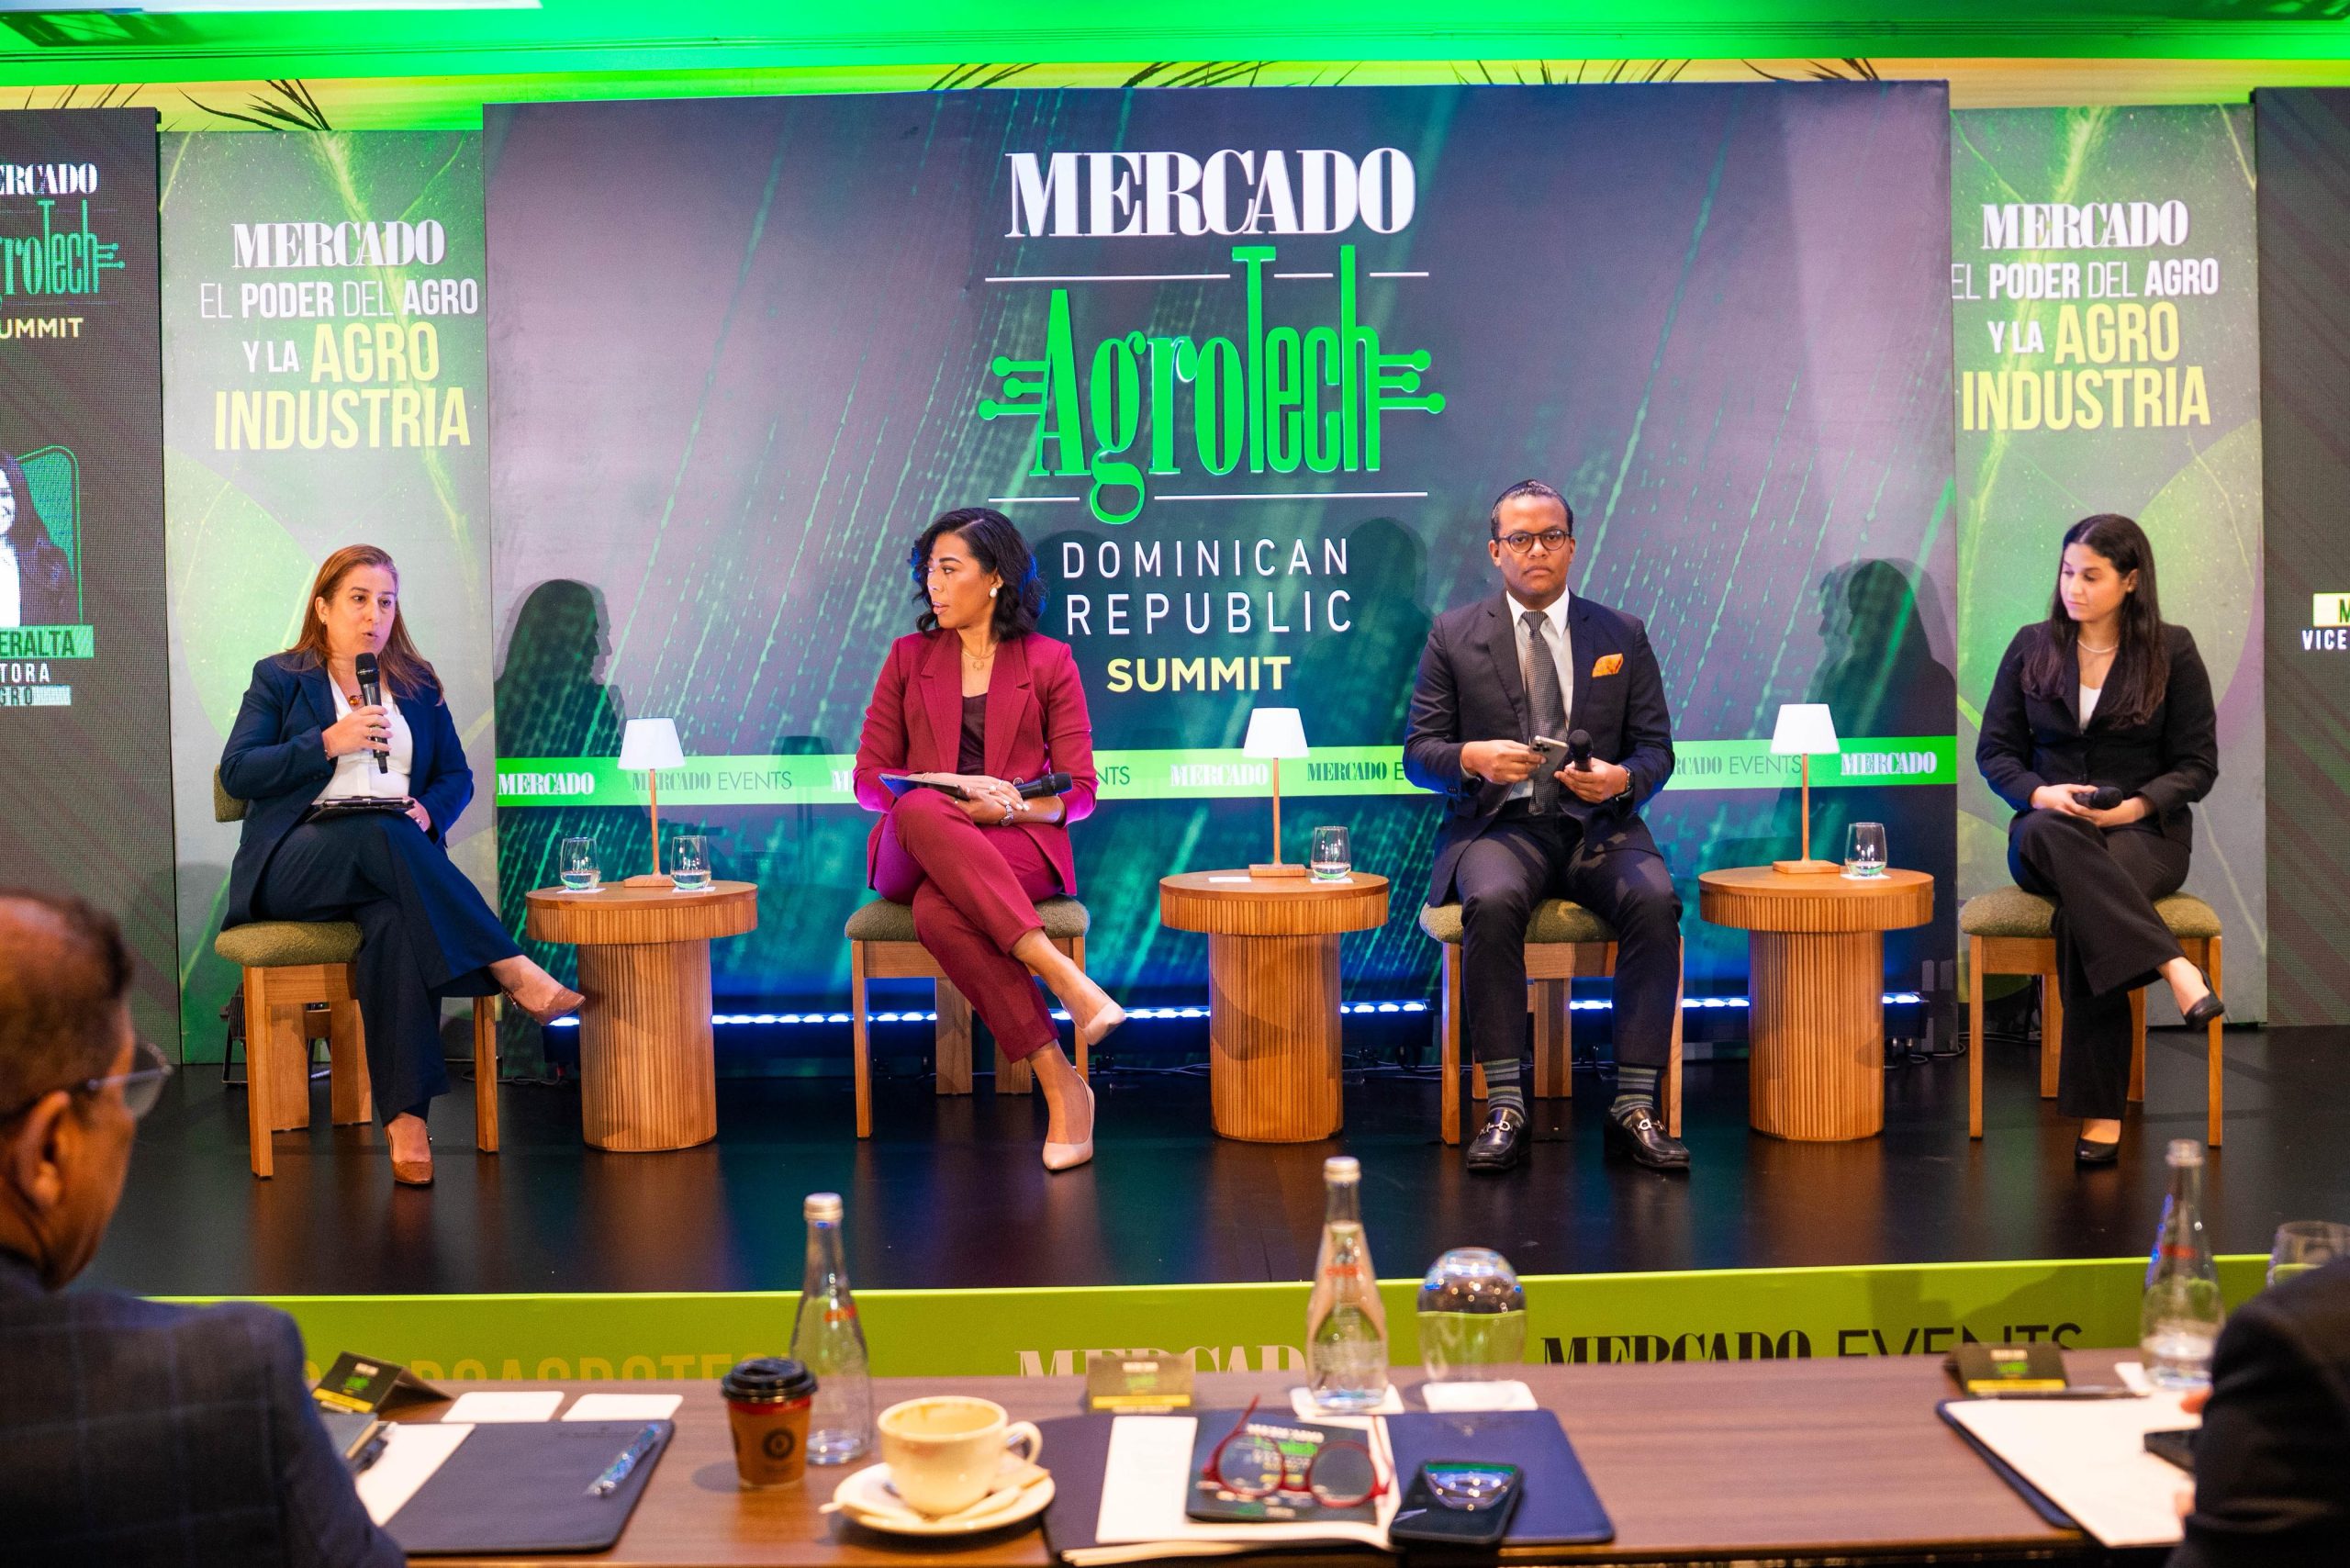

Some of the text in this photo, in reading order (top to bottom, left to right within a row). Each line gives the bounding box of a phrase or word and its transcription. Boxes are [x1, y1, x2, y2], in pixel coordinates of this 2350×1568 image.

[1005, 148, 1415, 238] MERCADO
[231, 219, 446, 268] MERCADO
[1981, 200, 2188, 250] MERCADO
[0, 198, 98, 295] roTech
[201, 278, 478, 319] EL PODER DEL AGRO
[1952, 257, 2219, 299] EL PODER DEL AGRO
[242, 321, 440, 383] Y LA AGRO
[1987, 301, 2179, 364] Y LA AGRO
[1029, 245, 1380, 524] AgroTech
[1963, 365, 2211, 431] INDUSTRIA
[214, 386, 470, 451] INDUSTRIA
[1063, 538, 1348, 579] DOMINICAN
[1067, 589, 1352, 635] REPUBLIC
[2302, 630, 2347, 650] VICE
[1107, 656, 1291, 692] SUMMIT
[498, 772, 595, 796] MERCADO
[718, 771, 791, 790] EVENTS
[1169, 763, 1269, 787] MERCADO
[1307, 761, 1387, 781] MERCADO
[1729, 756, 1802, 774] EVENTS
[1841, 751, 1937, 776] MERCADO
